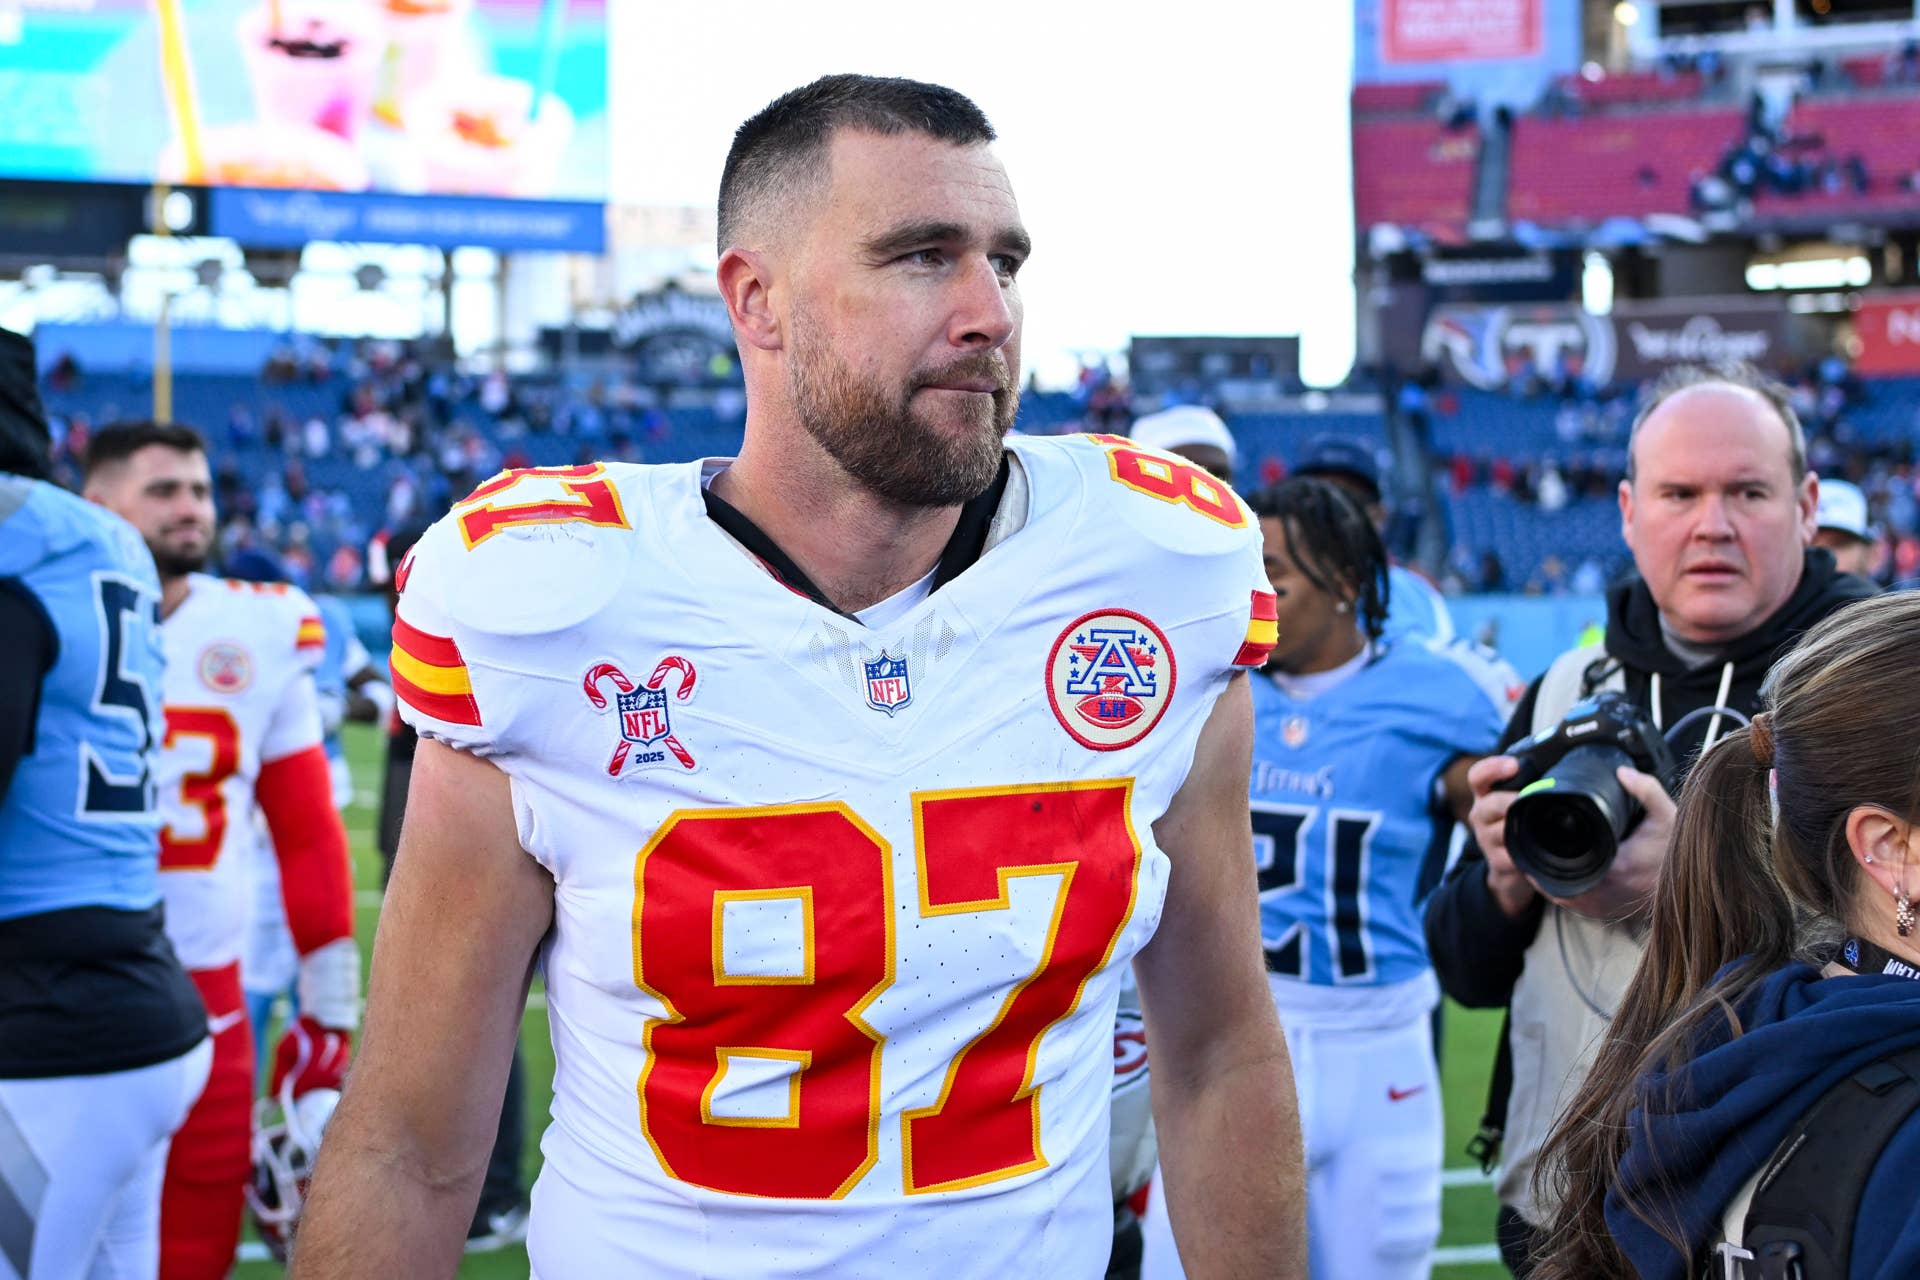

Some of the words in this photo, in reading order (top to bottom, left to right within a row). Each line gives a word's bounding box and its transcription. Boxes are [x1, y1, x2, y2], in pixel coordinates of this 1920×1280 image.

[1087, 434, 1248, 529] 8
[871, 678, 907, 704] NFL
[1098, 700, 1127, 718] LH
[624, 710, 666, 739] NFL
[635, 752, 665, 764] 2025
[1249, 801, 1383, 983] 21
[632, 777, 1142, 1200] 87
